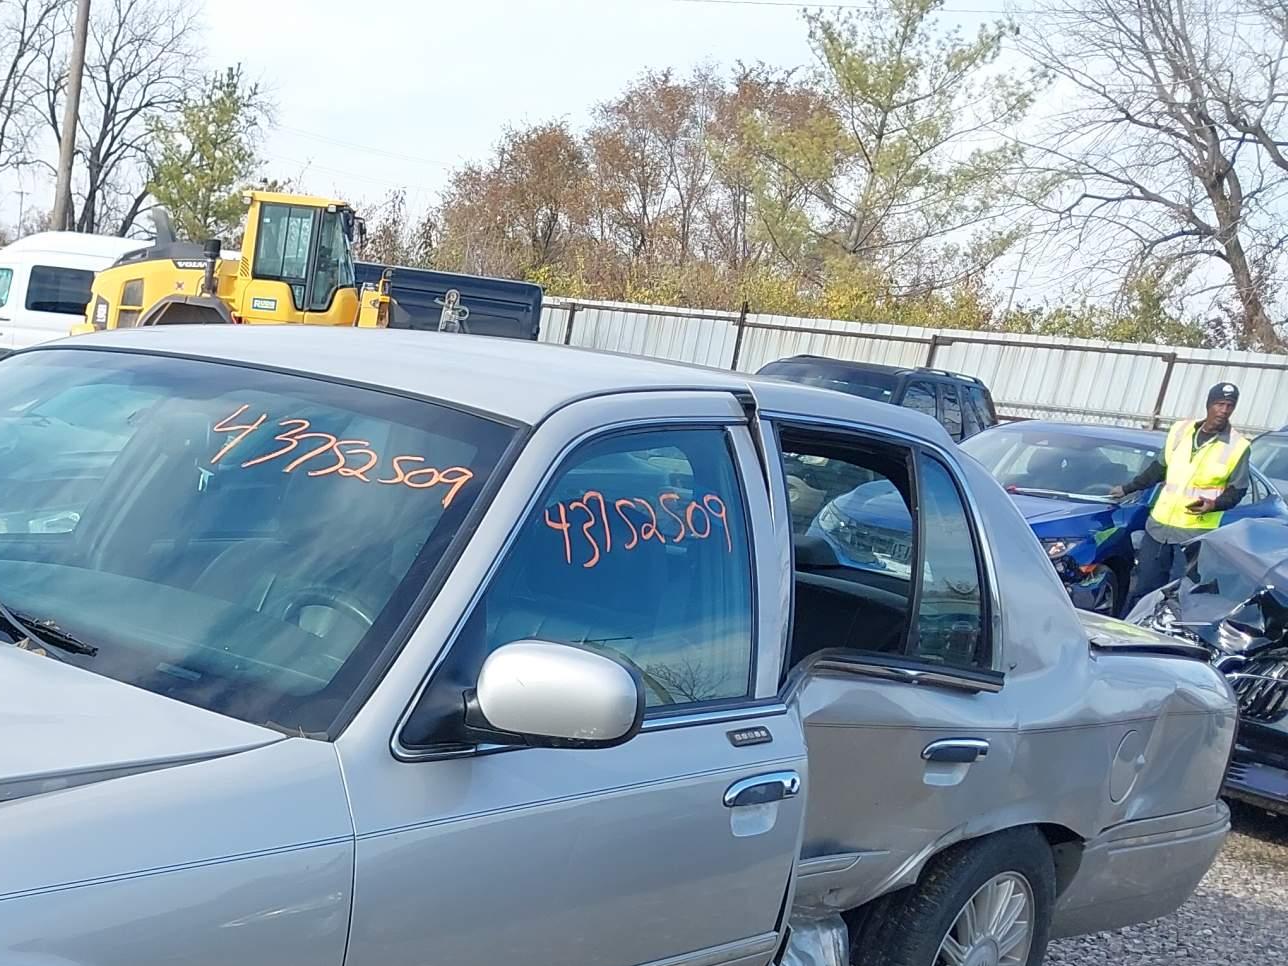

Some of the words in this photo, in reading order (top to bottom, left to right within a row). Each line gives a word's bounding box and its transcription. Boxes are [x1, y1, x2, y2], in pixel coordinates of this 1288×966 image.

[176, 260, 208, 268] VOLV
[209, 403, 474, 510] 43752509
[544, 488, 733, 568] 43752509
